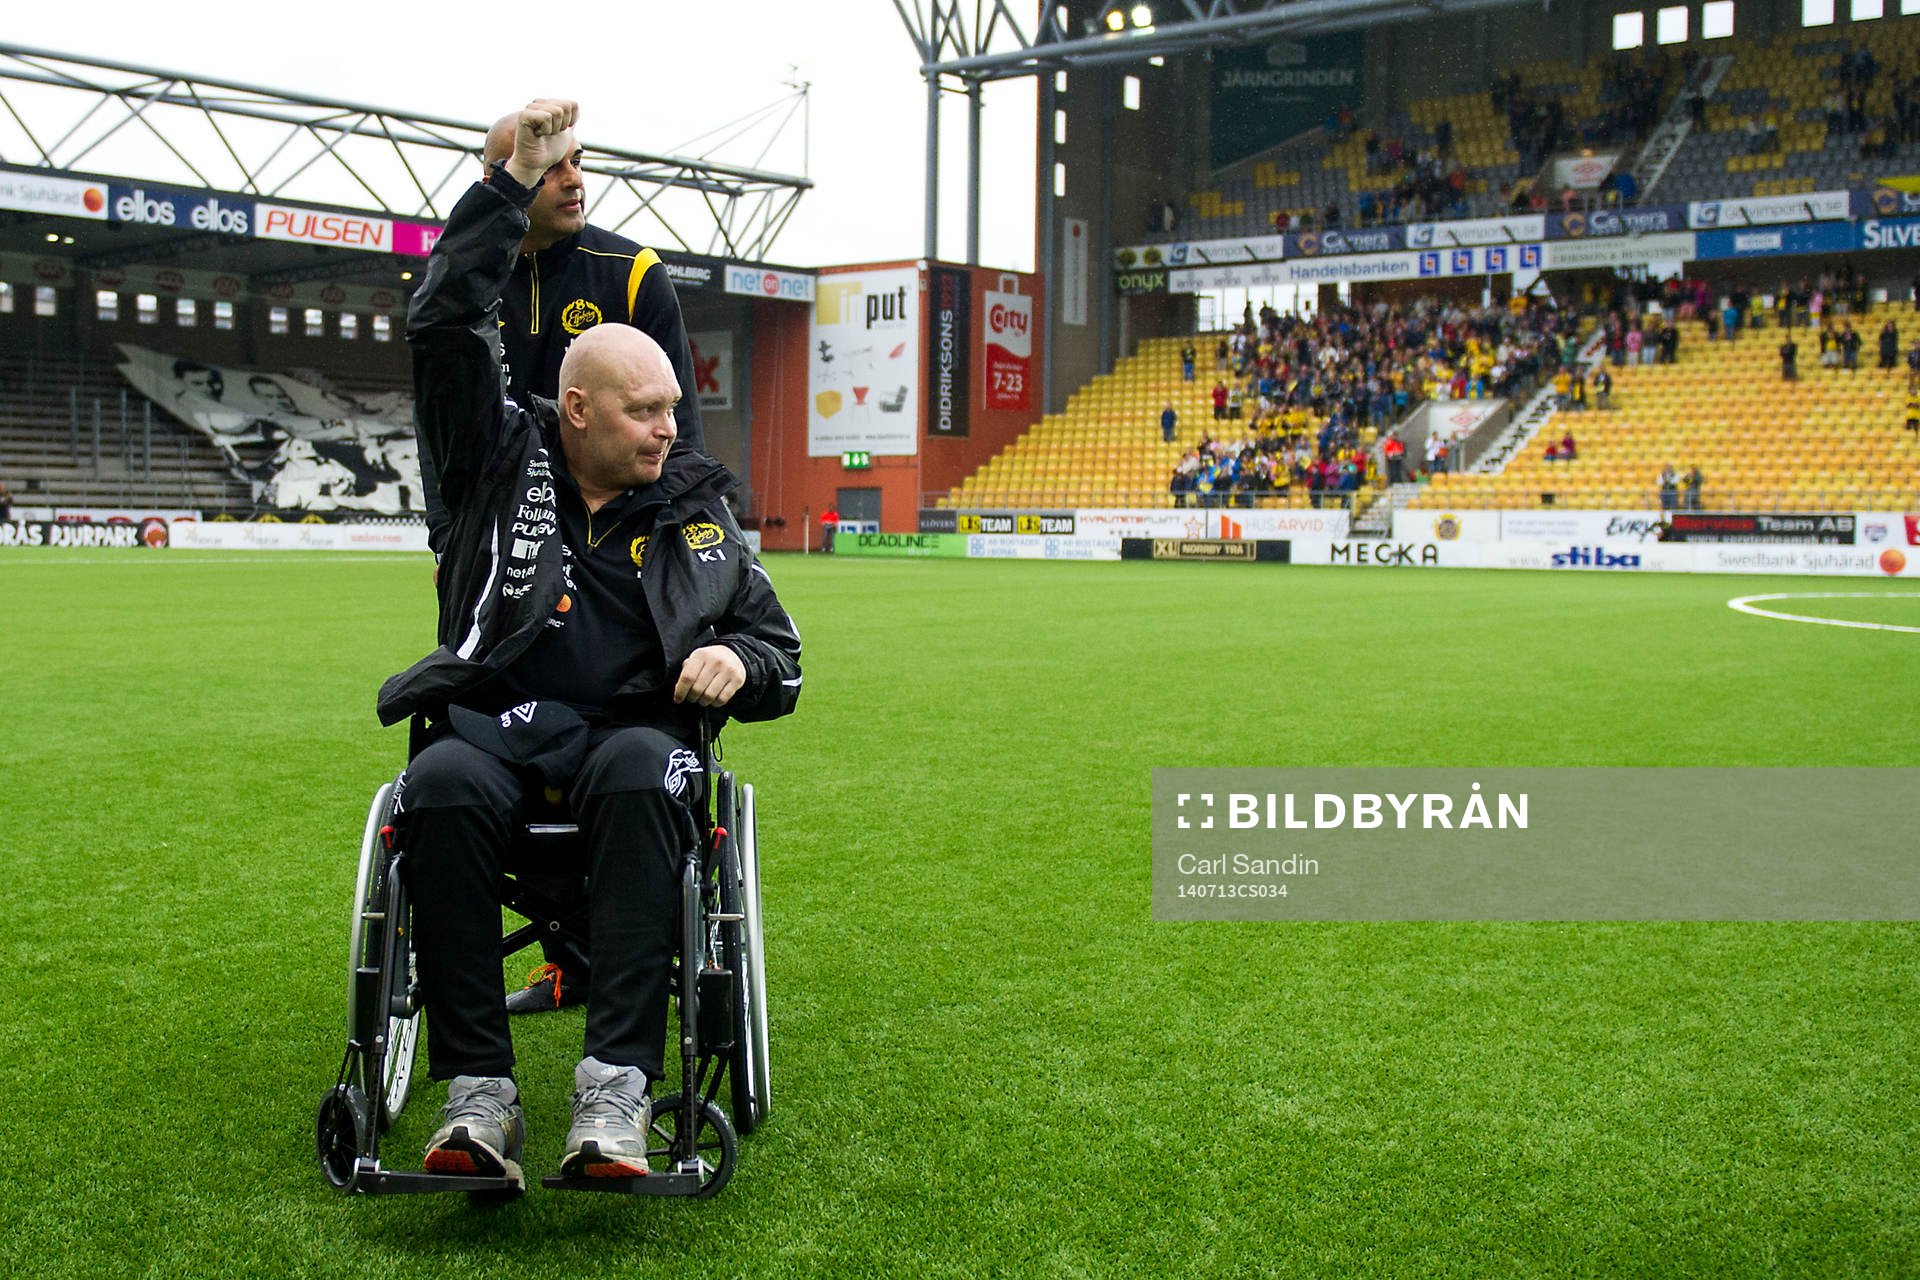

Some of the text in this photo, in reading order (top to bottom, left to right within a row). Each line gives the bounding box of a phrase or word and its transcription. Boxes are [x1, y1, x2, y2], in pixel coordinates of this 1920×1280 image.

[1222, 67, 1354, 87] JÄRNGRINDEN
[115, 188, 176, 226] ellos
[190, 197, 249, 235] ellos
[265, 209, 384, 246] PULSEN
[1290, 261, 1410, 281] Handelsbanken
[1118, 273, 1165, 294] onyx
[989, 303, 1029, 336] City
[938, 310, 953, 431] DIDRIKSONS
[993, 371, 1023, 392] 7-23
[1757, 516, 1815, 532] Team
[1818, 516, 1854, 532] AB
[1156, 541, 1178, 557] XL
[1551, 546, 1641, 567] stiba
[1717, 551, 1875, 571] Swedbank Sjuhärad
